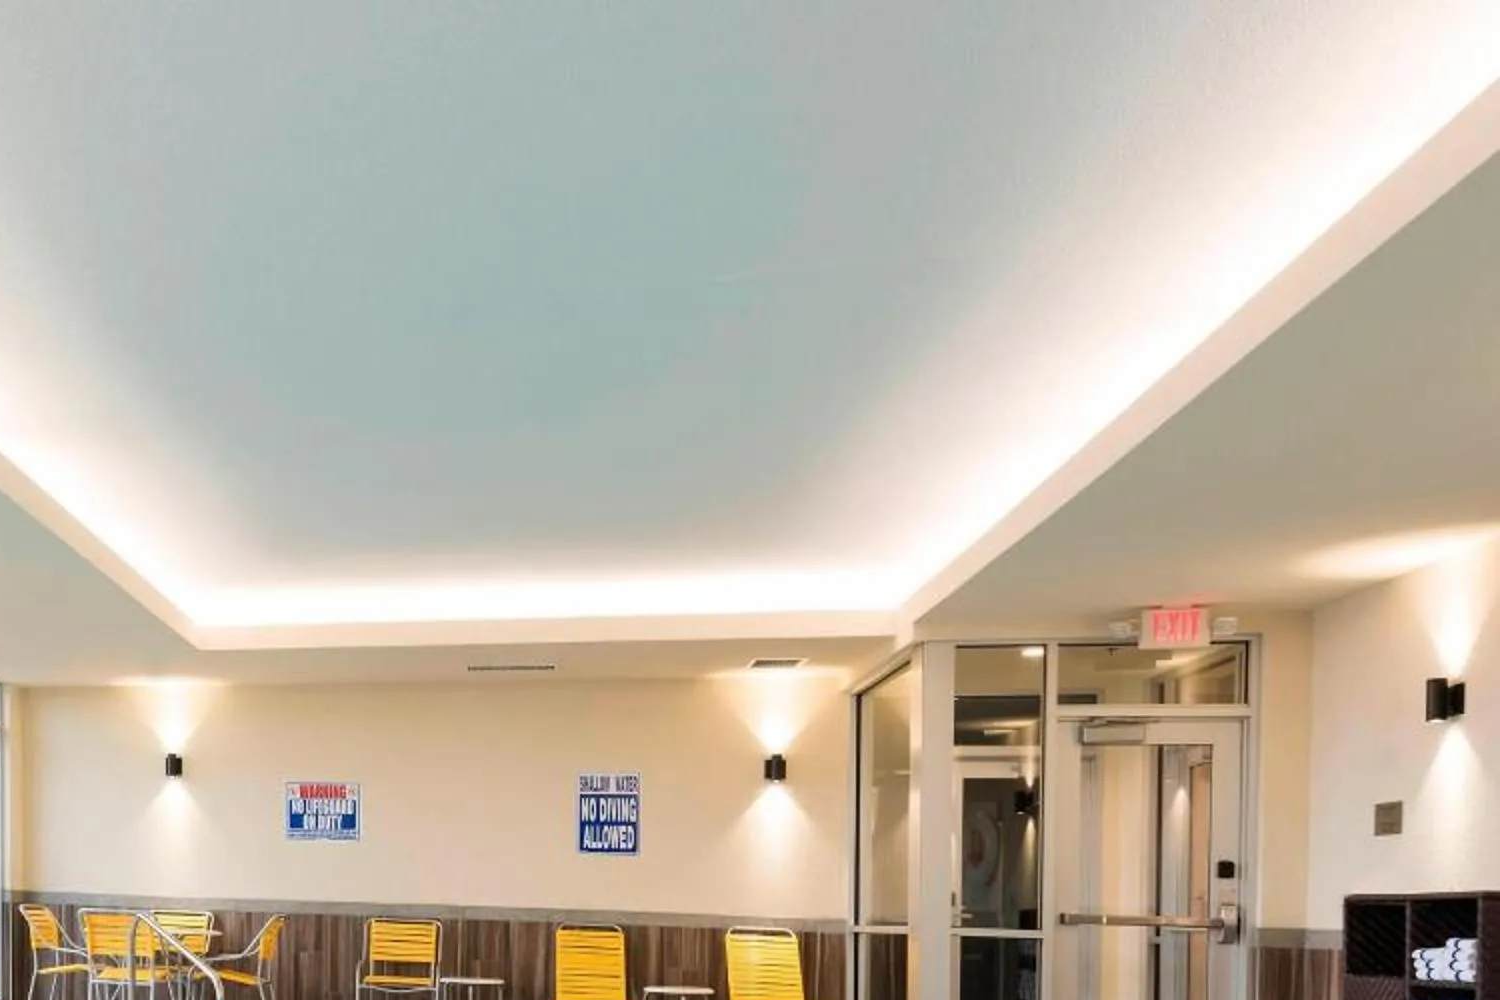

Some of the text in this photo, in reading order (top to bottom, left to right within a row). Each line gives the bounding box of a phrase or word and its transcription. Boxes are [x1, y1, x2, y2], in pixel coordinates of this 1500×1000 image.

[1153, 611, 1201, 643] EXIT
[299, 784, 347, 799] WARNING
[580, 776, 610, 792] SHALLOW
[292, 799, 305, 814] NO
[581, 797, 637, 822] NO DIVING
[318, 815, 342, 830] DUTY
[583, 824, 635, 850] ALLOWED
